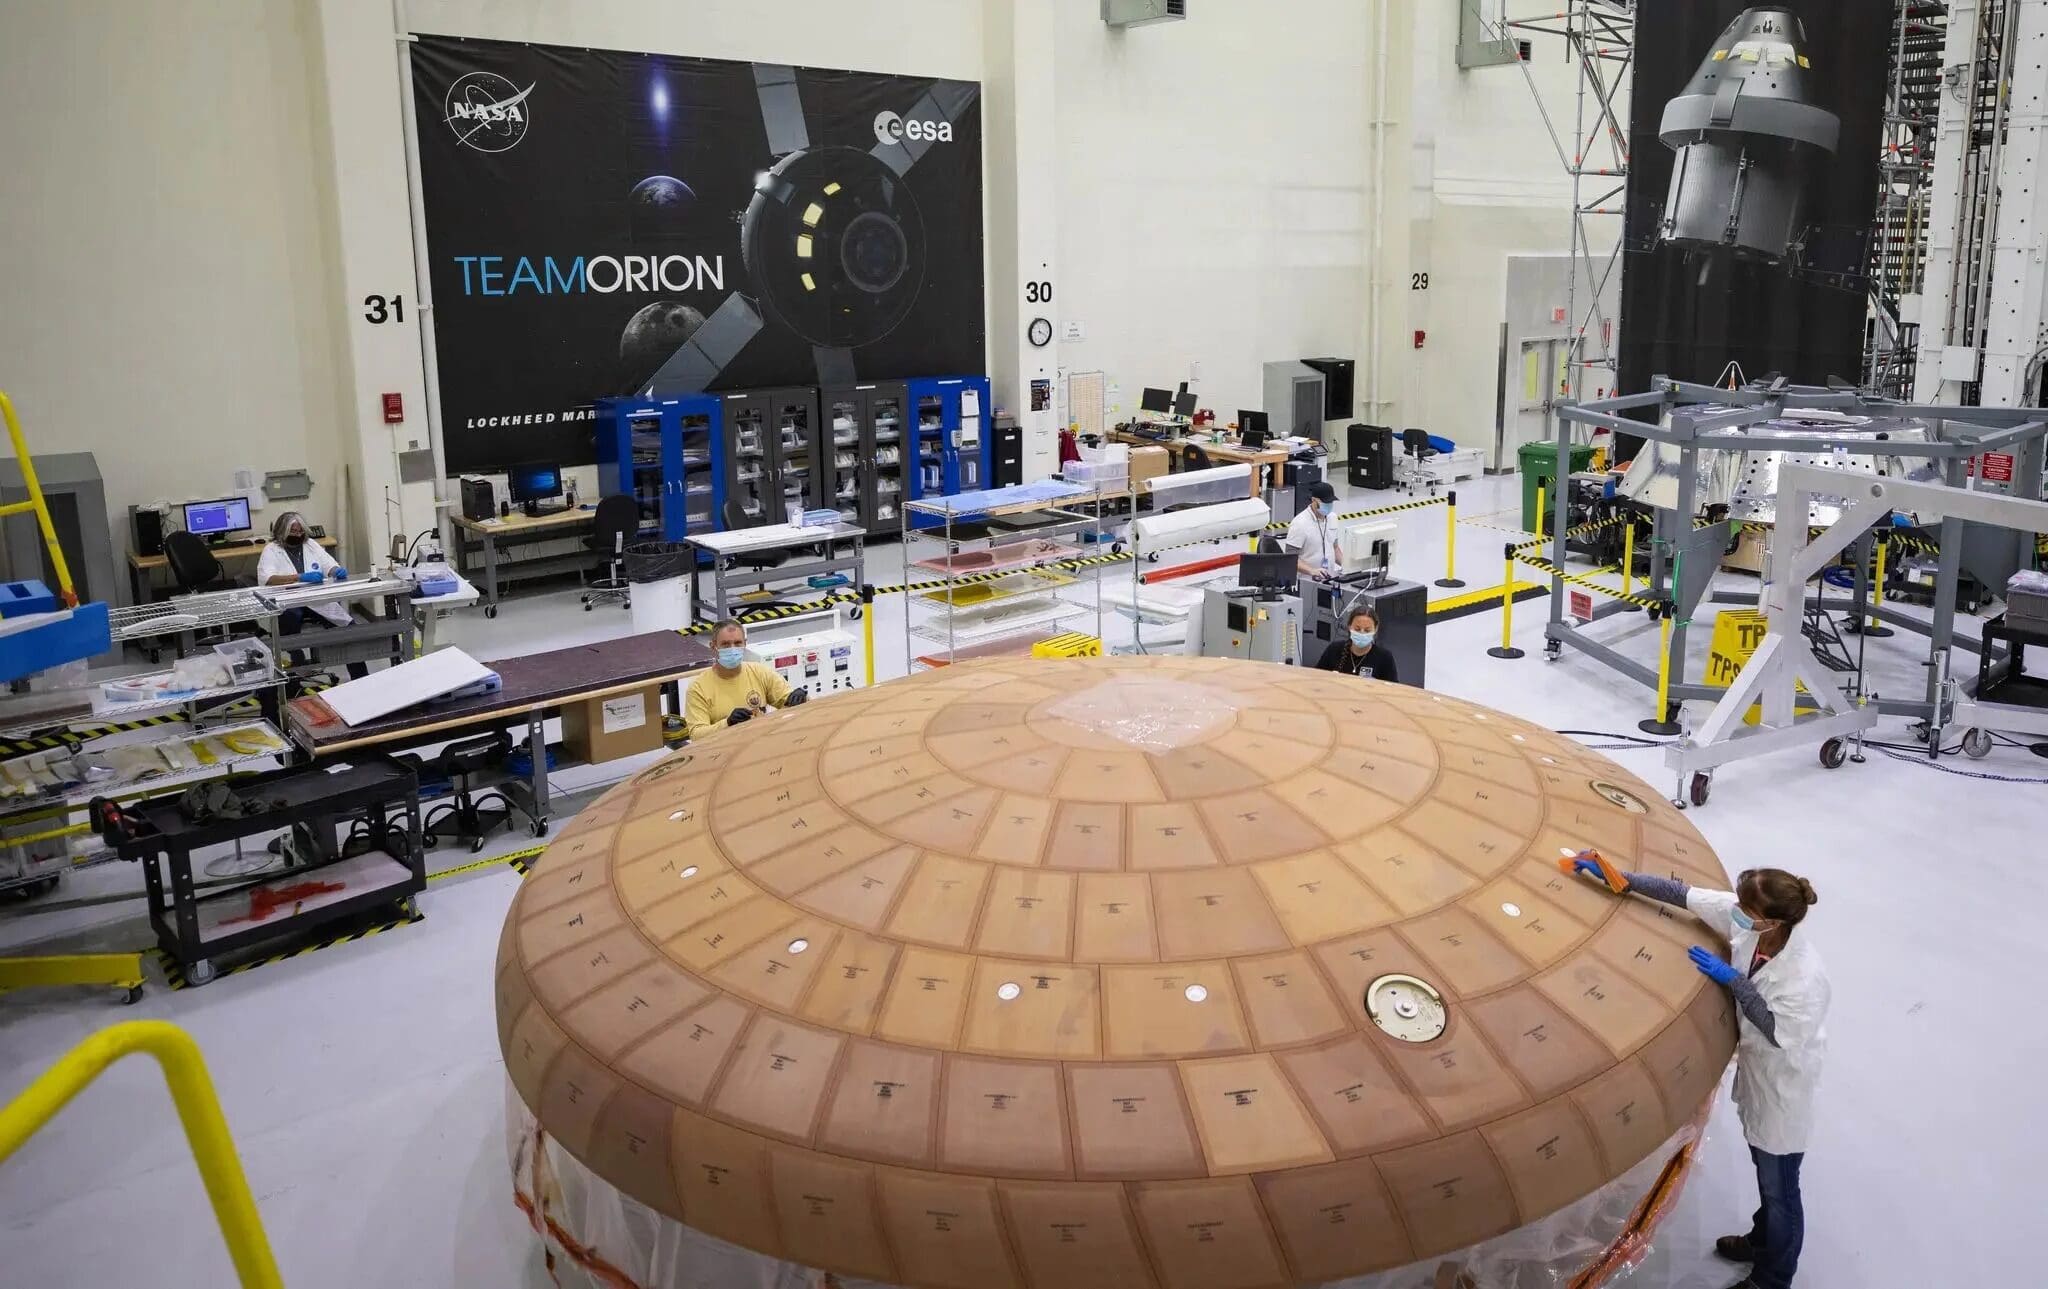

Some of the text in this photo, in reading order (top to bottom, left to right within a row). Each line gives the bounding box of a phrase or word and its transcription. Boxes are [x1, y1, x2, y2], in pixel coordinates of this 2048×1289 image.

[453, 102, 524, 122] NASA
[905, 119, 953, 142] esa
[1026, 281, 1052, 303] 30
[1412, 272, 1429, 290] 29
[364, 294, 404, 324] 31
[467, 409, 597, 429] LOCKHEED MAR
[1738, 624, 1767, 649] TP
